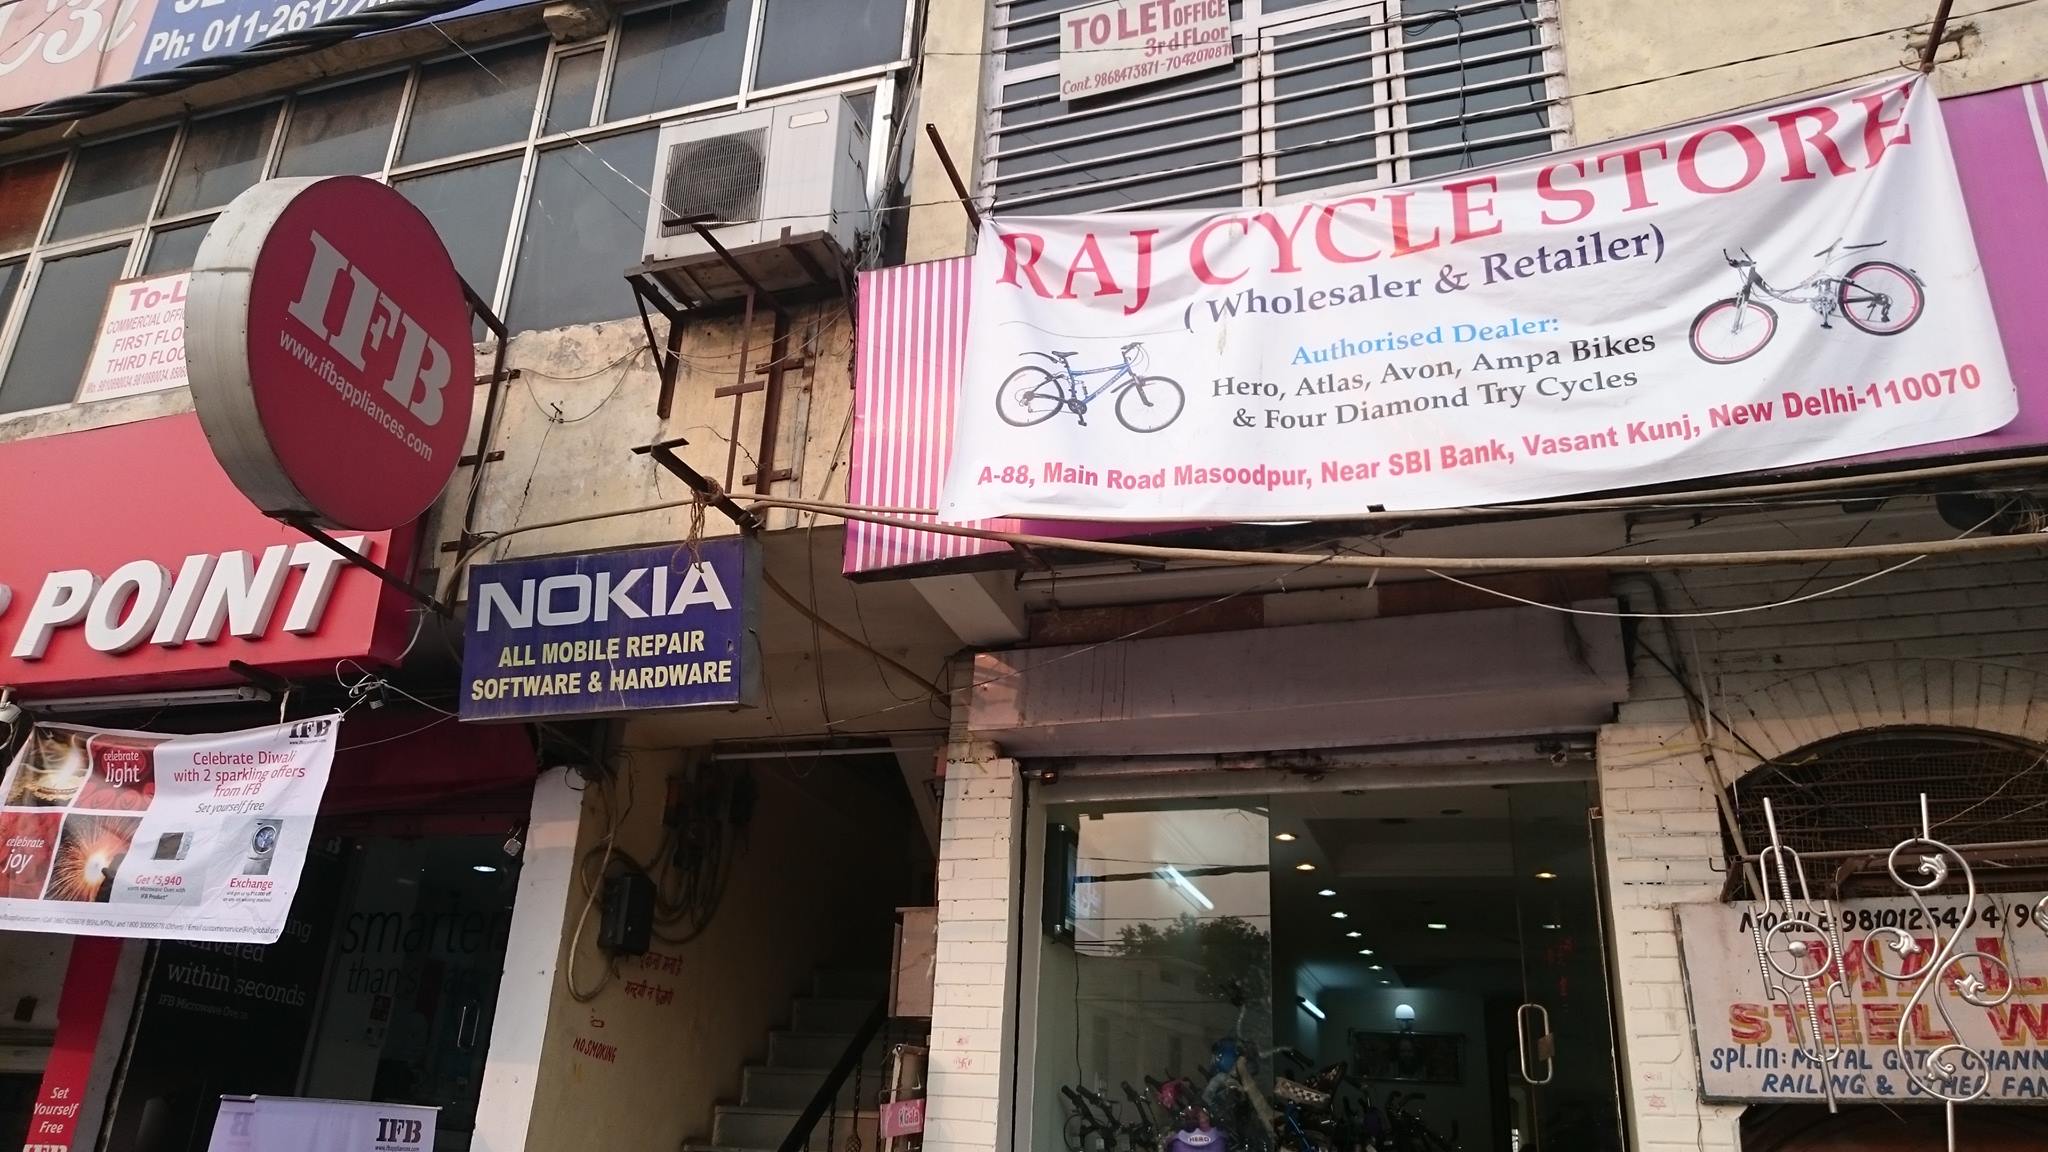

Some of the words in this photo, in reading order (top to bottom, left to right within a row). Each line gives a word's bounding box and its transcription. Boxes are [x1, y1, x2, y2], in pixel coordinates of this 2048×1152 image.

[1067, 14, 1111, 50] TO
[1118, 0, 1175, 41] LET
[1173, 0, 1227, 27] OFFICE
[144, 30, 196, 64] Ph:
[1144, 32, 1179, 58] 3rd
[1062, 77, 1092, 95] Cont.
[995, 228, 1159, 315] RAJ
[1190, 175, 1502, 285] CYCLE
[1536, 82, 1911, 225] STORE
[1435, 264, 1470, 295] &
[1479, 223, 1665, 287] Retailer)
[106, 313, 161, 335] COMMERCIAL
[287, 229, 452, 427] IFB
[112, 333, 153, 353] FIRST
[154, 326, 185, 345] FLO
[1290, 328, 1443, 367] Authorised
[1454, 317, 1560, 344] Dealer:
[106, 353, 147, 374] THIRD
[1211, 376, 1286, 401] Hero,
[1294, 372, 1373, 398] Atlas,
[1380, 360, 1462, 385] Avon,
[1471, 349, 1561, 378] Ampa
[1569, 331, 1657, 363] Bikes
[279, 329, 433, 462] www.ifbappliances.com
[1232, 409, 1257, 428] &
[1263, 408, 1328, 430] Four
[1335, 387, 1468, 426] Diamond
[1476, 380, 1527, 408] Try
[1535, 368, 1639, 401] Cycles
[977, 464, 1036, 489] A-88,
[1043, 462, 1099, 487] Main
[1106, 468, 1166, 490] Road
[1173, 463, 1313, 491] Masoodpur,
[1320, 458, 1381, 484] Near
[1388, 446, 1432, 476] SBI
[1440, 438, 1516, 470] Bank,
[1521, 425, 1618, 457] Vasant
[1627, 413, 1701, 444] Kunj,
[1708, 397, 1775, 429] New
[1780, 363, 1982, 419] Delhi-110070
[11, 535, 372, 660] POINT
[476, 560, 733, 632] NOKIA
[498, 645, 536, 668] ALL
[541, 638, 621, 665] MOBILE
[626, 630, 705, 658] REPAIR
[471, 671, 582, 701] SOFTWARE
[587, 670, 603, 693] &
[609, 660, 732, 692] HARDWARE
[288, 719, 332, 738] IFB
[103, 750, 140, 762] celebrate
[193, 751, 254, 766] Celebrate
[258, 750, 297, 765] Diwali
[105, 762, 140, 788] light
[174, 768, 200, 782] with
[203, 768, 211, 782] 2
[215, 767, 269, 785] sparkling
[270, 764, 306, 779] offers
[214, 784, 241, 798] from
[242, 782, 262, 796] IFB
[195, 802, 210, 814] Set
[210, 800, 244, 816] yourself
[243, 800, 265, 814] free
[6, 836, 45, 848] celebrate
[2, 849, 34, 874] joy
[135, 875, 151, 885] Get
[229, 877, 274, 891] Exchange
[167, 961, 231, 993] within
[233, 978, 306, 1007] seconds
[347, 957, 401, 994] than
[1728, 1003, 1954, 1047] STEEL
[1882, 1049, 1943, 1071] GAT
[50, 1087, 70, 1099] Set
[1875, 1074, 1895, 1096] &
[33, 1102, 80, 1119] Yourself
[39, 1121, 64, 1134] Free
[376, 1118, 422, 1143] IFB
